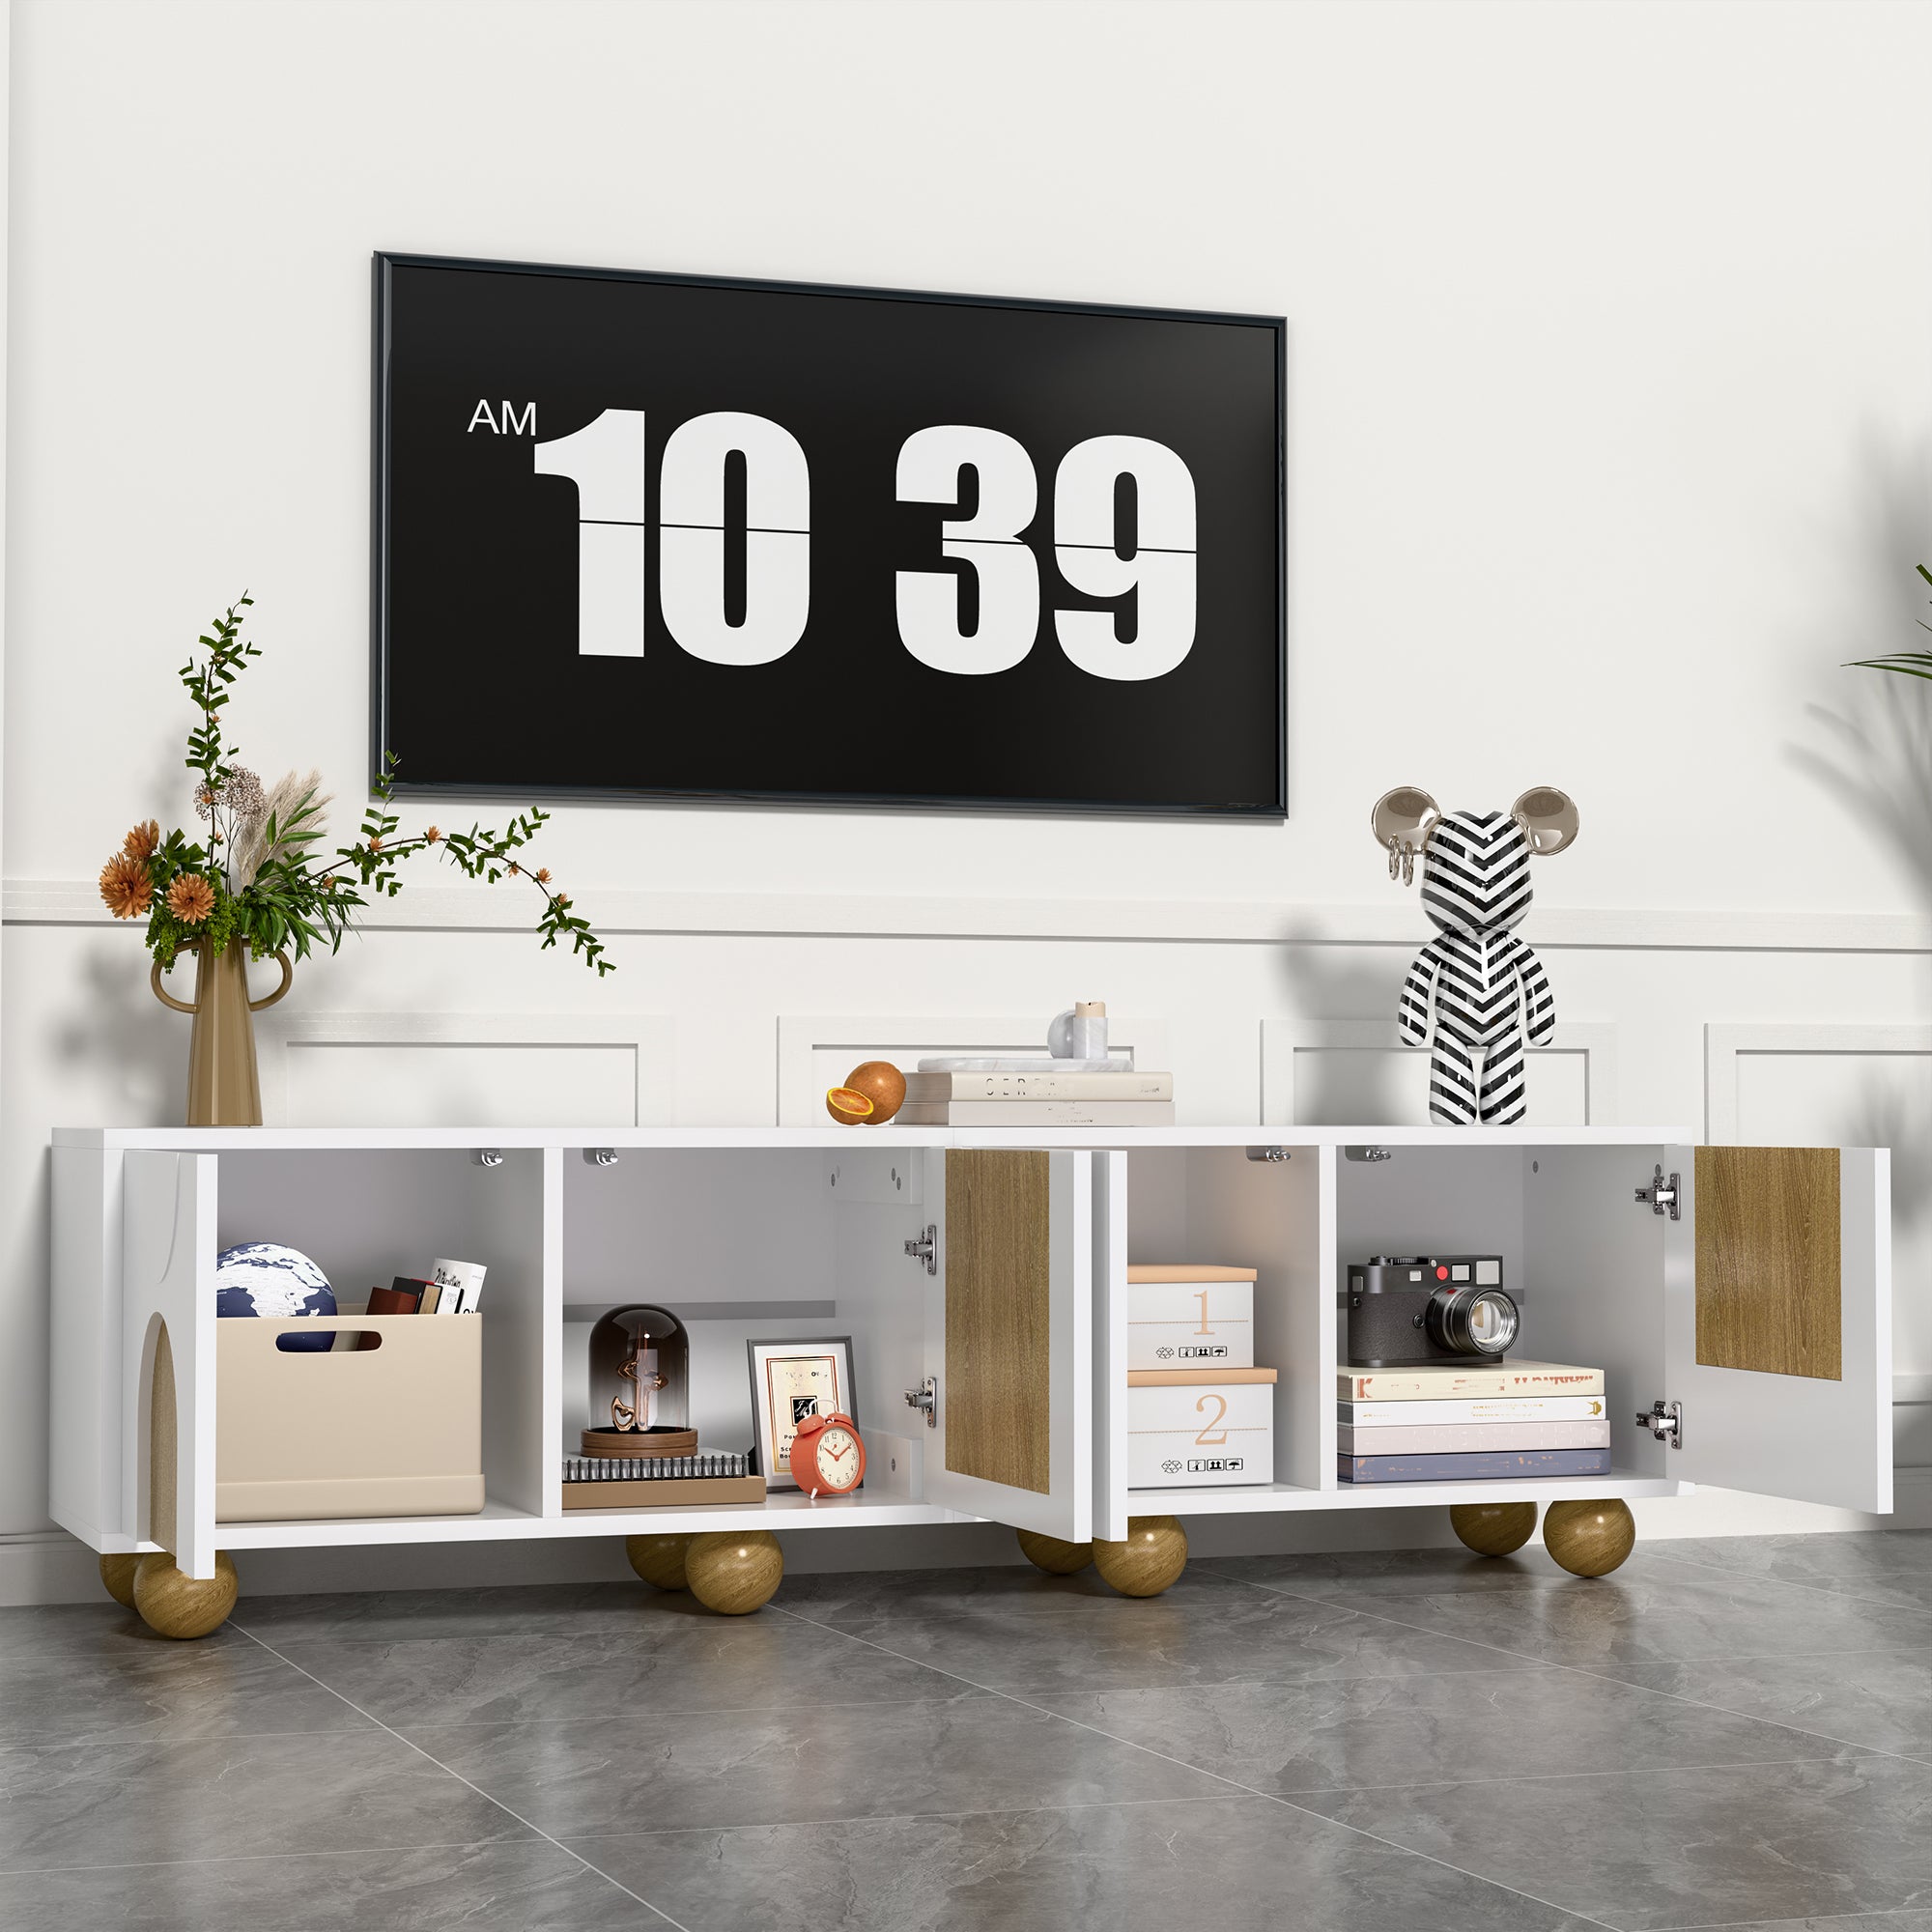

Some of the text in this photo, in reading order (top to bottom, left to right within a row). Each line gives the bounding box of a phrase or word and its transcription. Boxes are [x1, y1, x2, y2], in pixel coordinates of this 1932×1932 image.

[467, 399, 536, 437] AM
[533, 408, 1198, 681] 10 39
[1193, 1290, 1215, 1335] 1
[1195, 1394, 1228, 1445] 2
